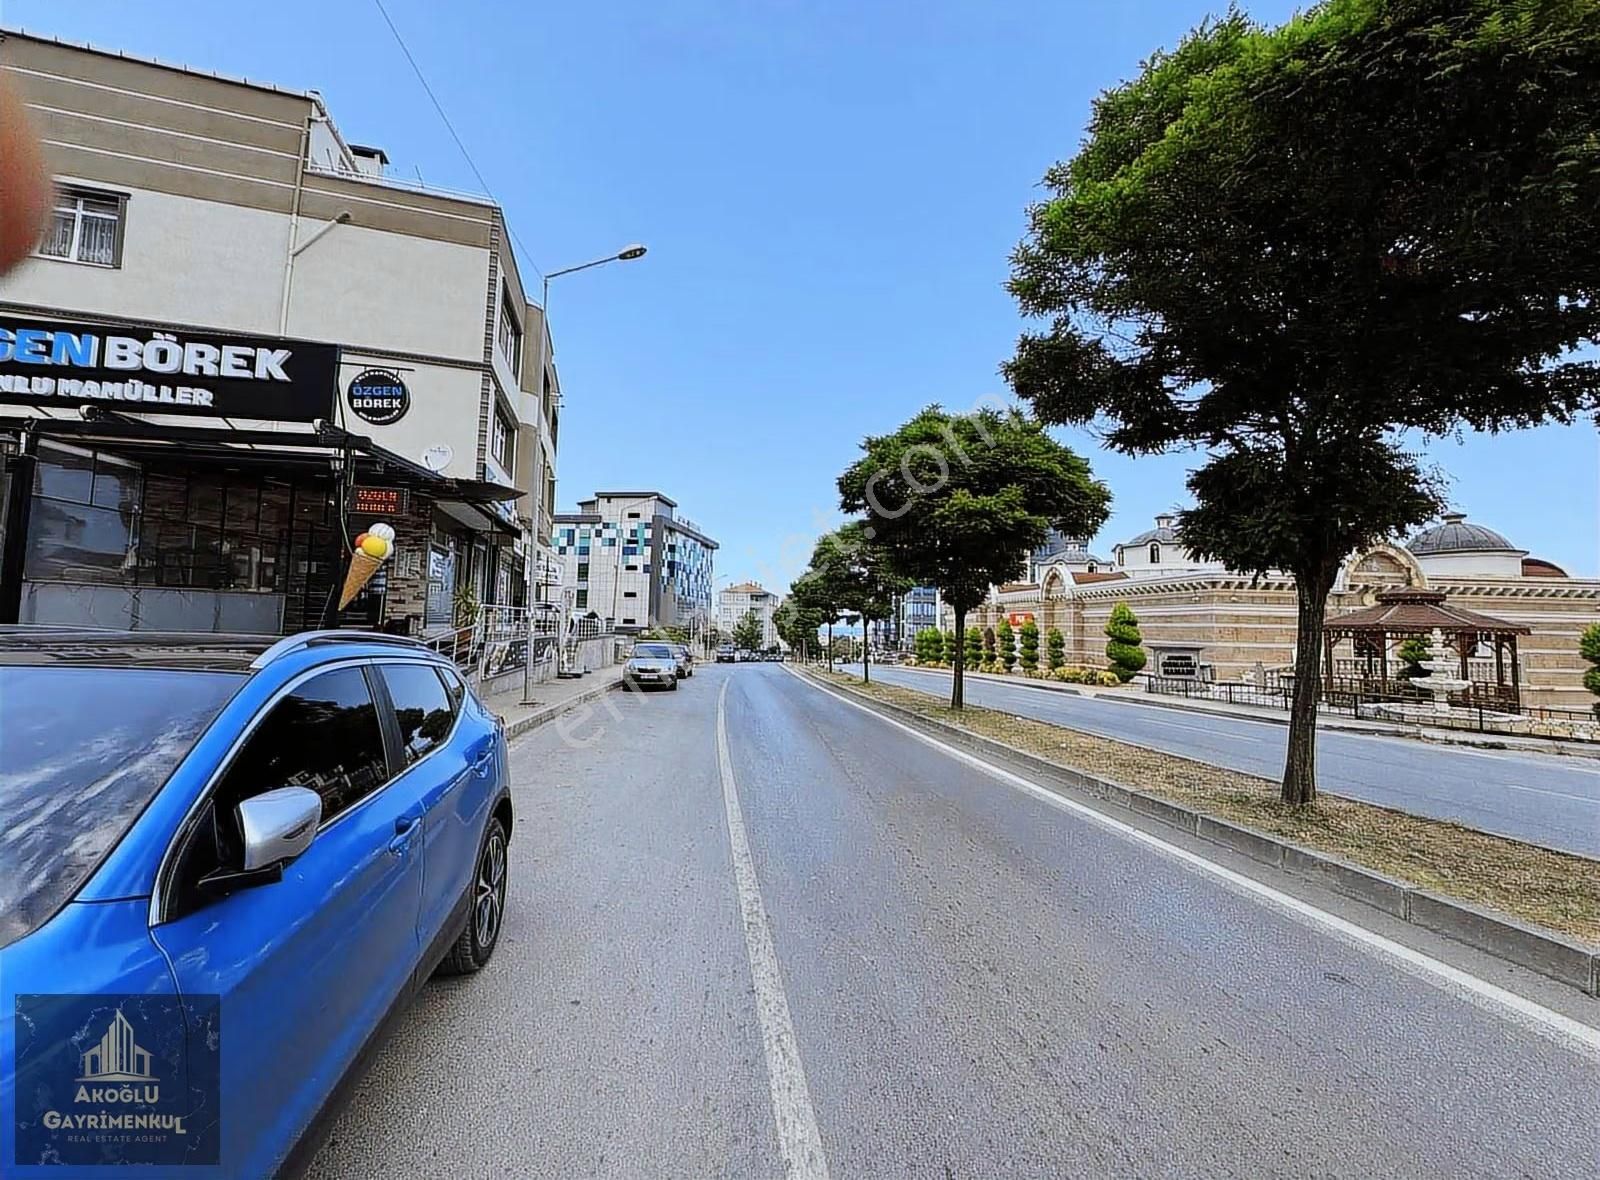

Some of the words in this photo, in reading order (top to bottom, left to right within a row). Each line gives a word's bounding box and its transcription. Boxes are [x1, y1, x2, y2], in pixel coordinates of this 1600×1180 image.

[104, 332, 292, 382] BÖREK
[58, 378, 214, 407] MAMÜLLER
[352, 384, 402, 396] ÖZGEN
